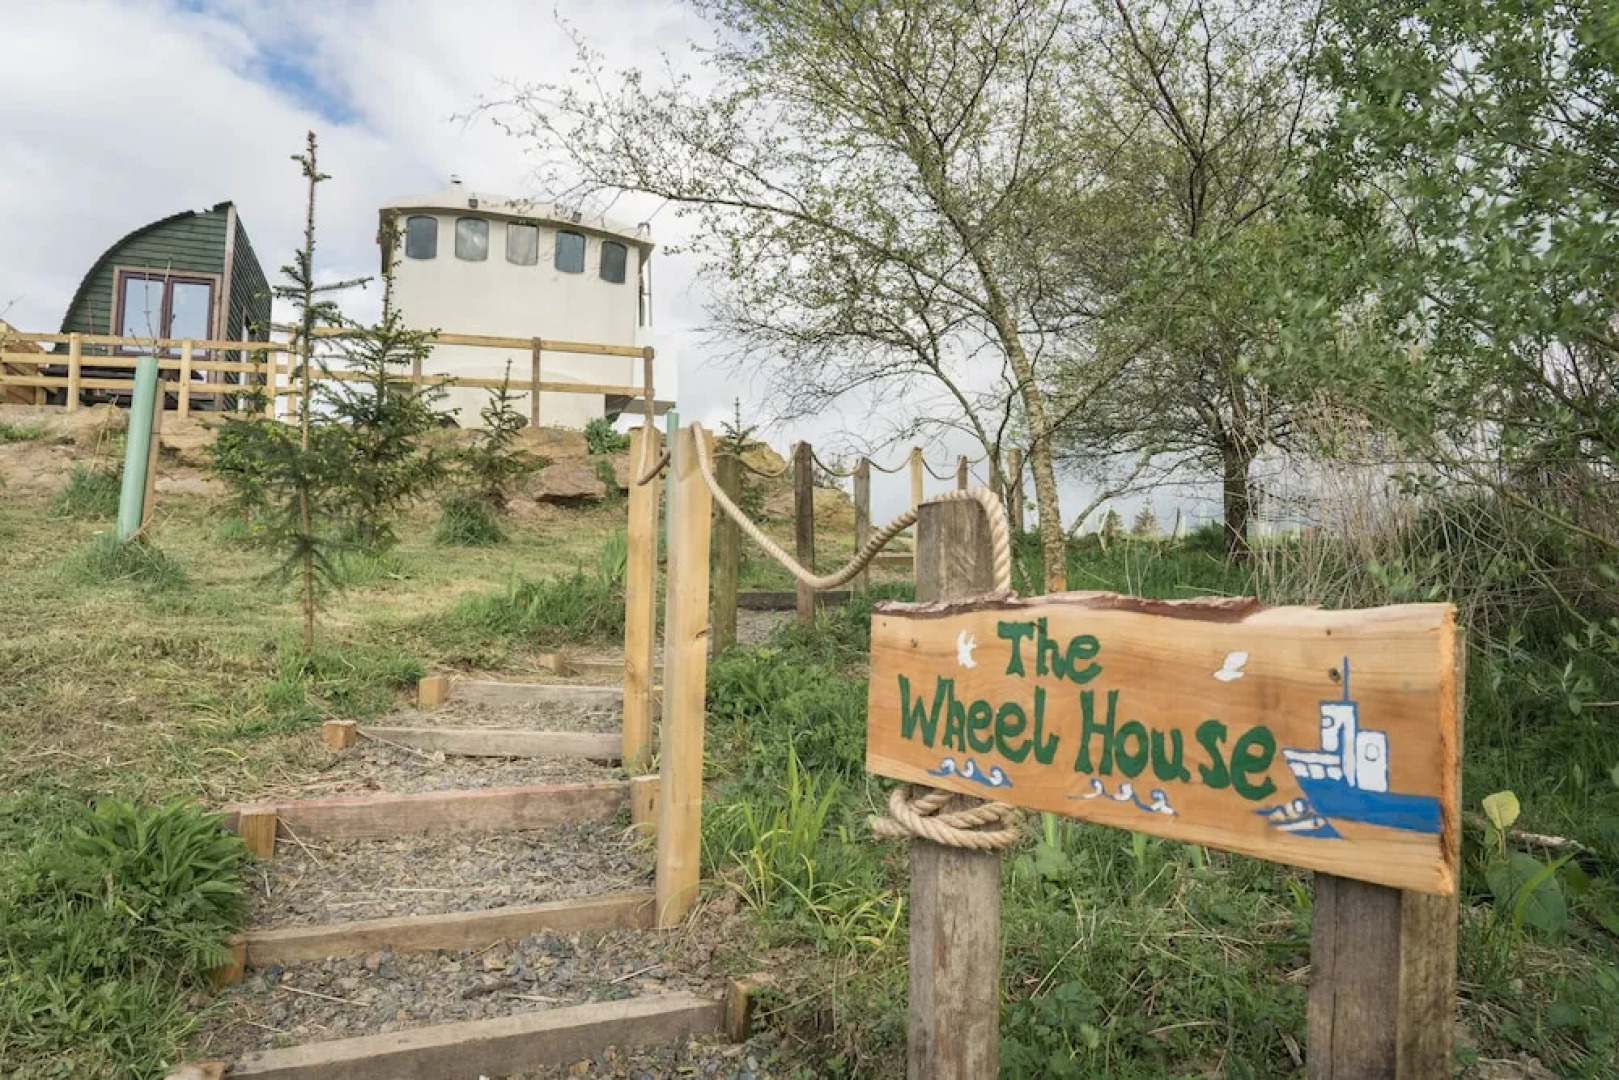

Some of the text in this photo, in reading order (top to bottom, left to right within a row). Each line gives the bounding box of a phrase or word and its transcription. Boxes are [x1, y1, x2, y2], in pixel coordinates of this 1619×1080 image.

[998, 618, 1101, 684] The
[898, 674, 1277, 800] Wheel House
